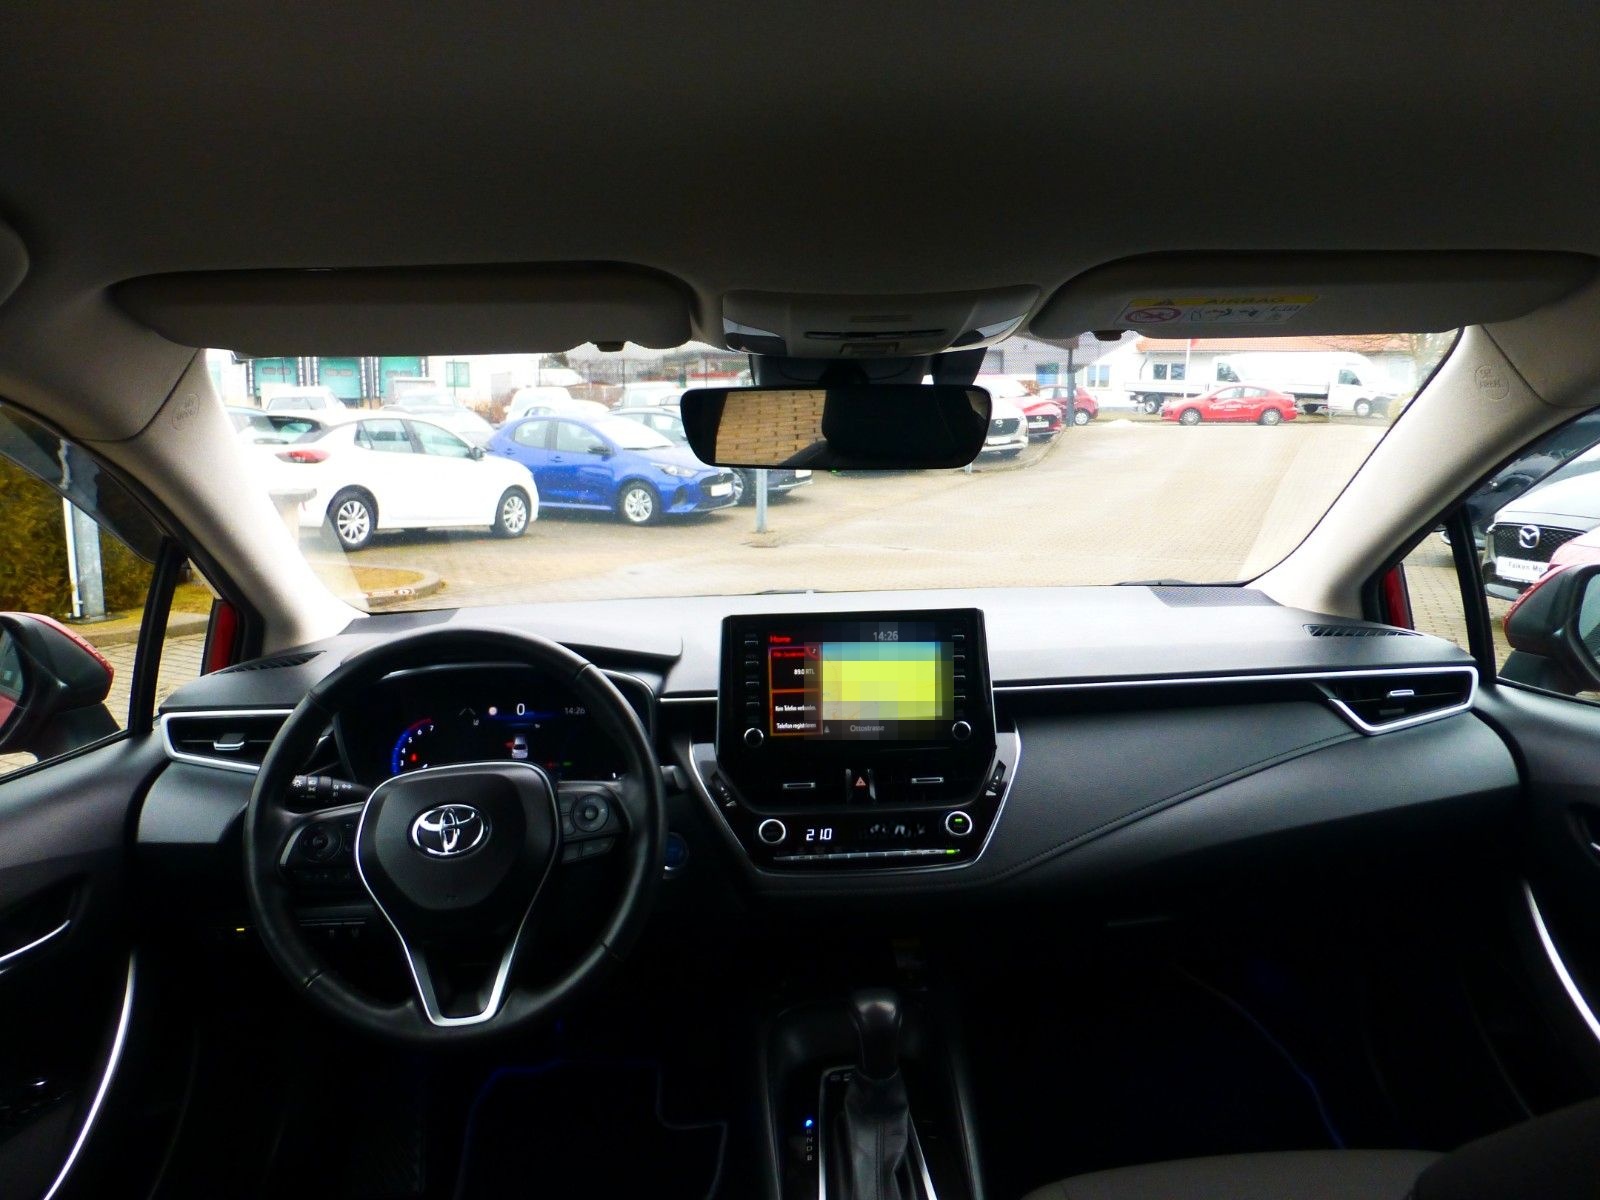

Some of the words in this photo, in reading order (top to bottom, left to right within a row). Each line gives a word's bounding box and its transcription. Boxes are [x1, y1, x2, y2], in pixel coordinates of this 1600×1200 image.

[873, 630, 899, 641] 14:26
[516, 703, 525, 716] 0
[849, 724, 885, 732] Ottostrasse
